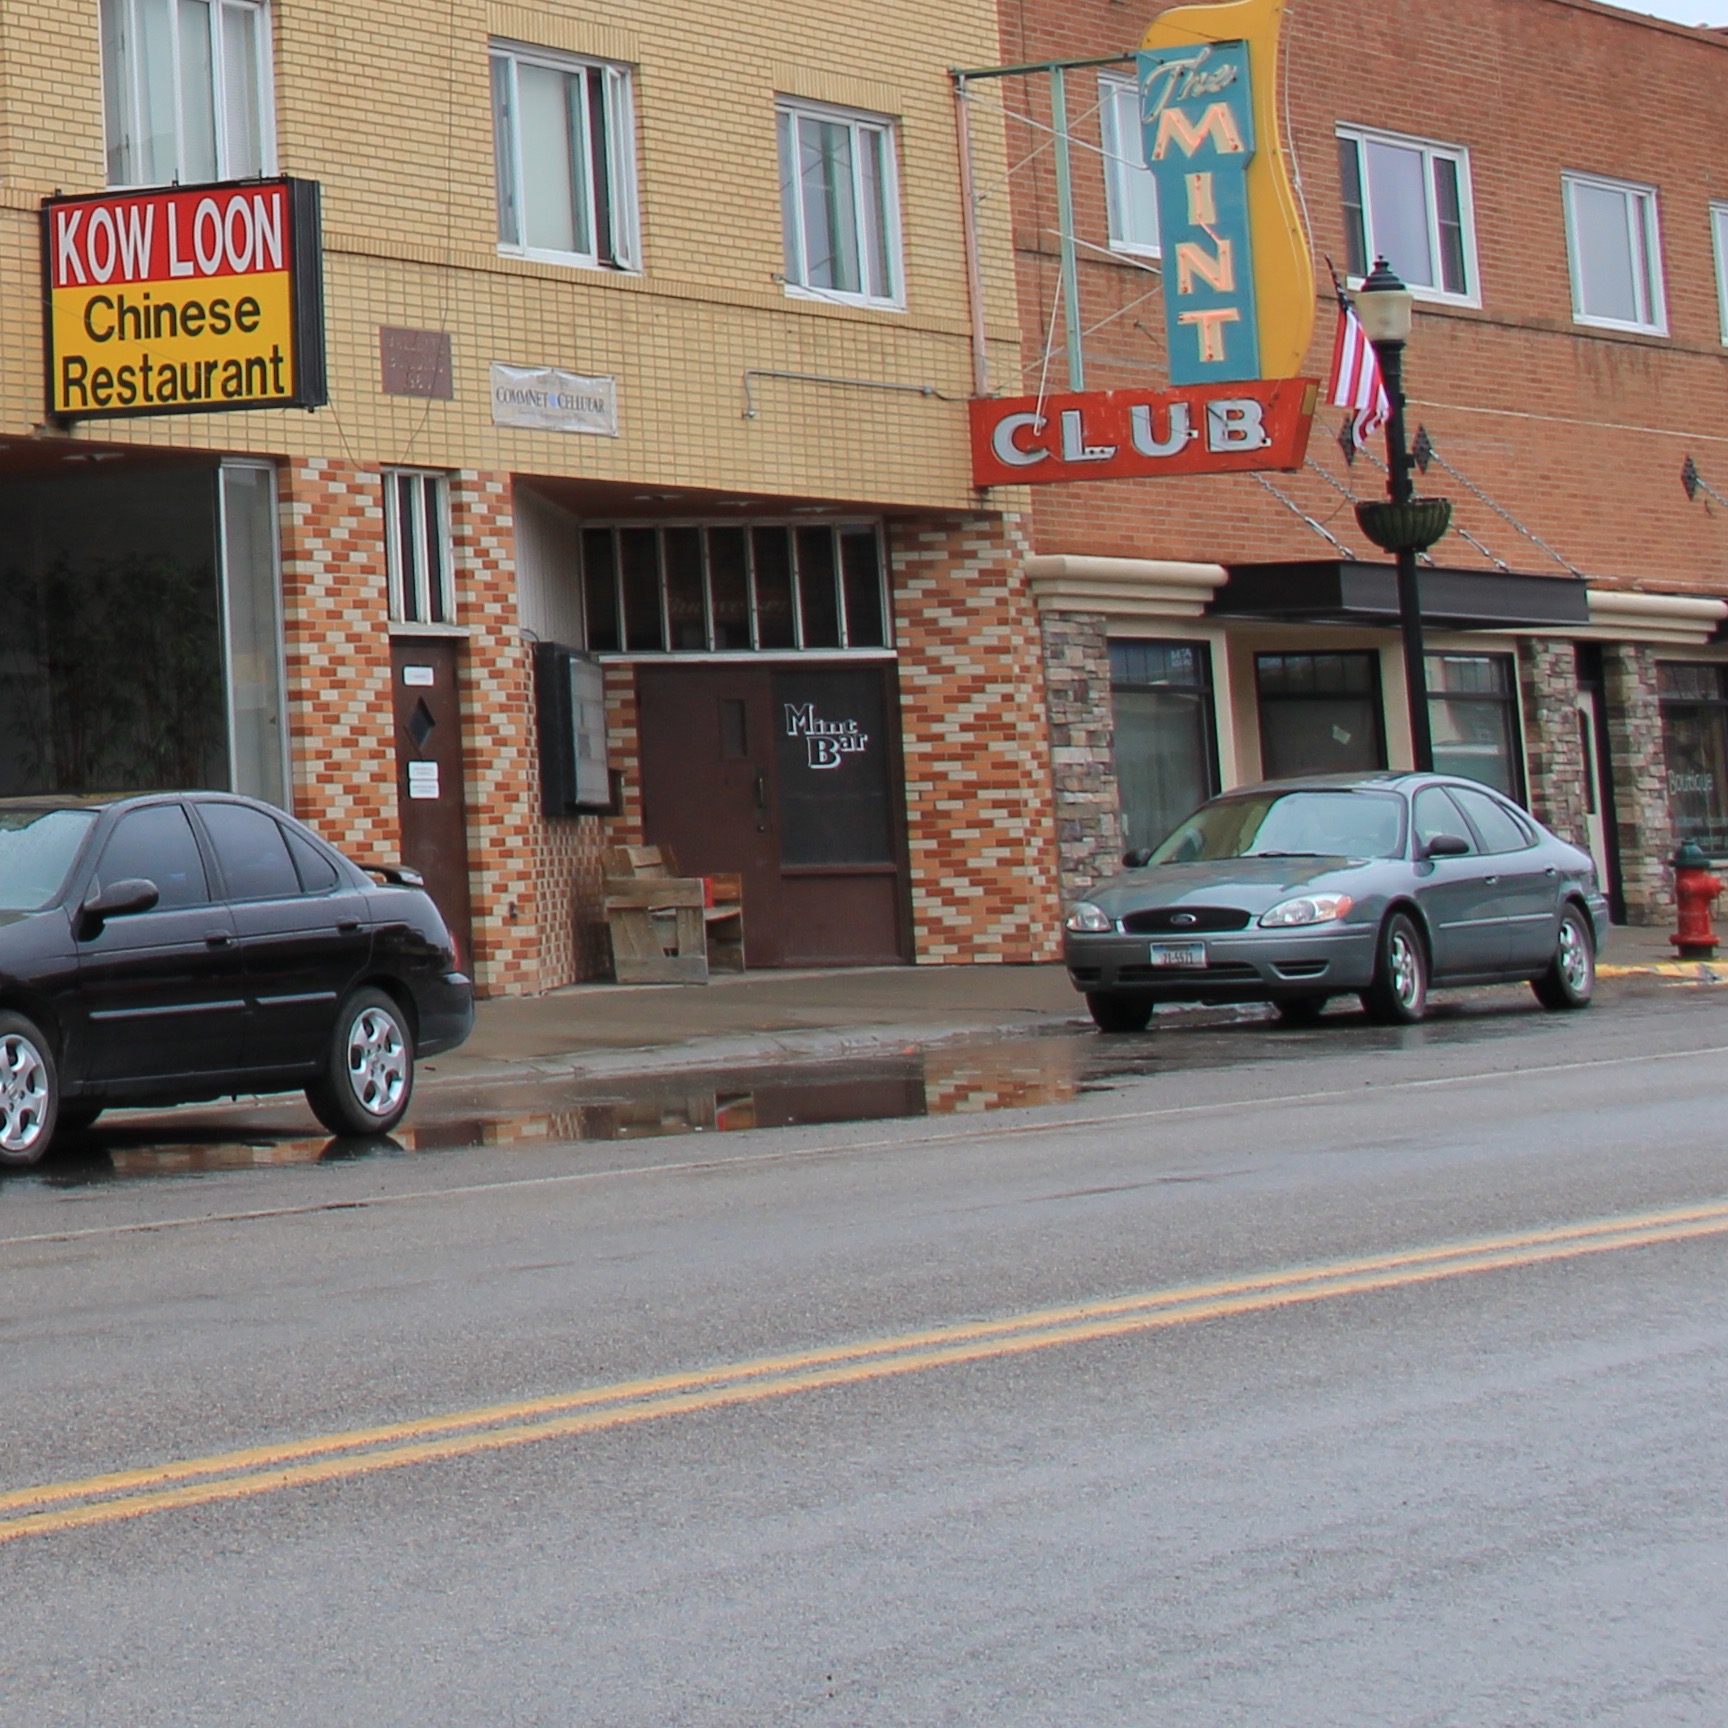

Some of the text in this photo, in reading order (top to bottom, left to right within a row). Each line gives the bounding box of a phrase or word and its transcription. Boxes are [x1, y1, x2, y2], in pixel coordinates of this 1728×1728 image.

[1139, 46, 1238, 124] The
[57, 192, 284, 286] KOW LOON
[1151, 102, 1246, 364] MINT
[84, 293, 261, 343] Chinese
[62, 344, 286, 408] Restaurant
[992, 397, 1272, 467] CLUB
[784, 702, 859, 736] Mint
[806, 733, 869, 770] Bar
